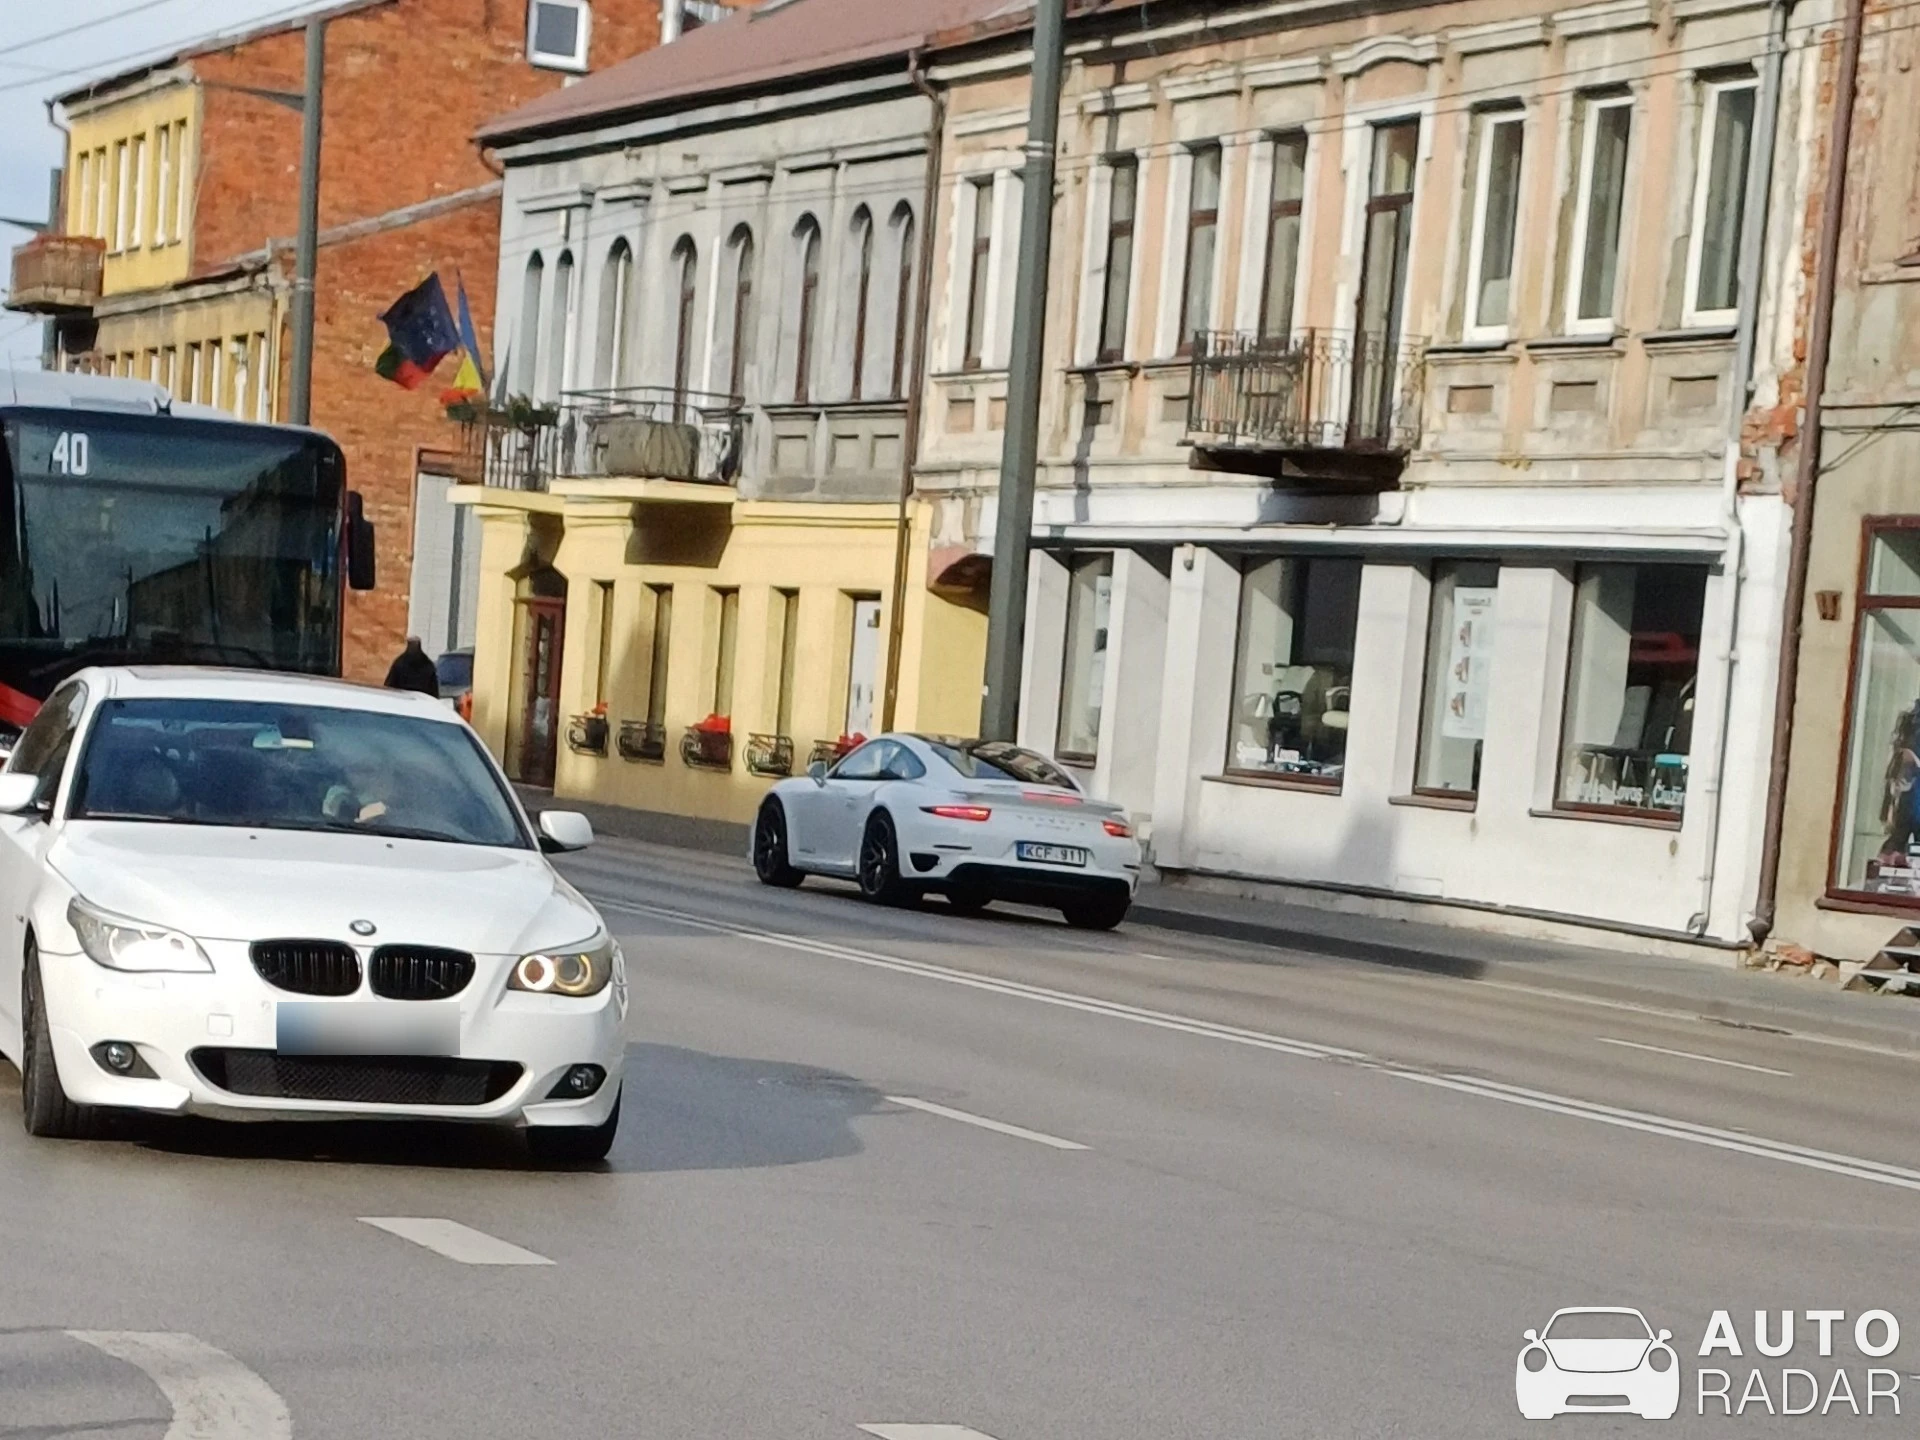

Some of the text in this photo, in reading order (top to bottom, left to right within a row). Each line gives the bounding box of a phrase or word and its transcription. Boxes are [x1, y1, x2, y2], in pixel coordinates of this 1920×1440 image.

[52, 431, 88, 475] 40
[1025, 844, 1052, 859] KCF
[1061, 848, 1082, 862] 911
